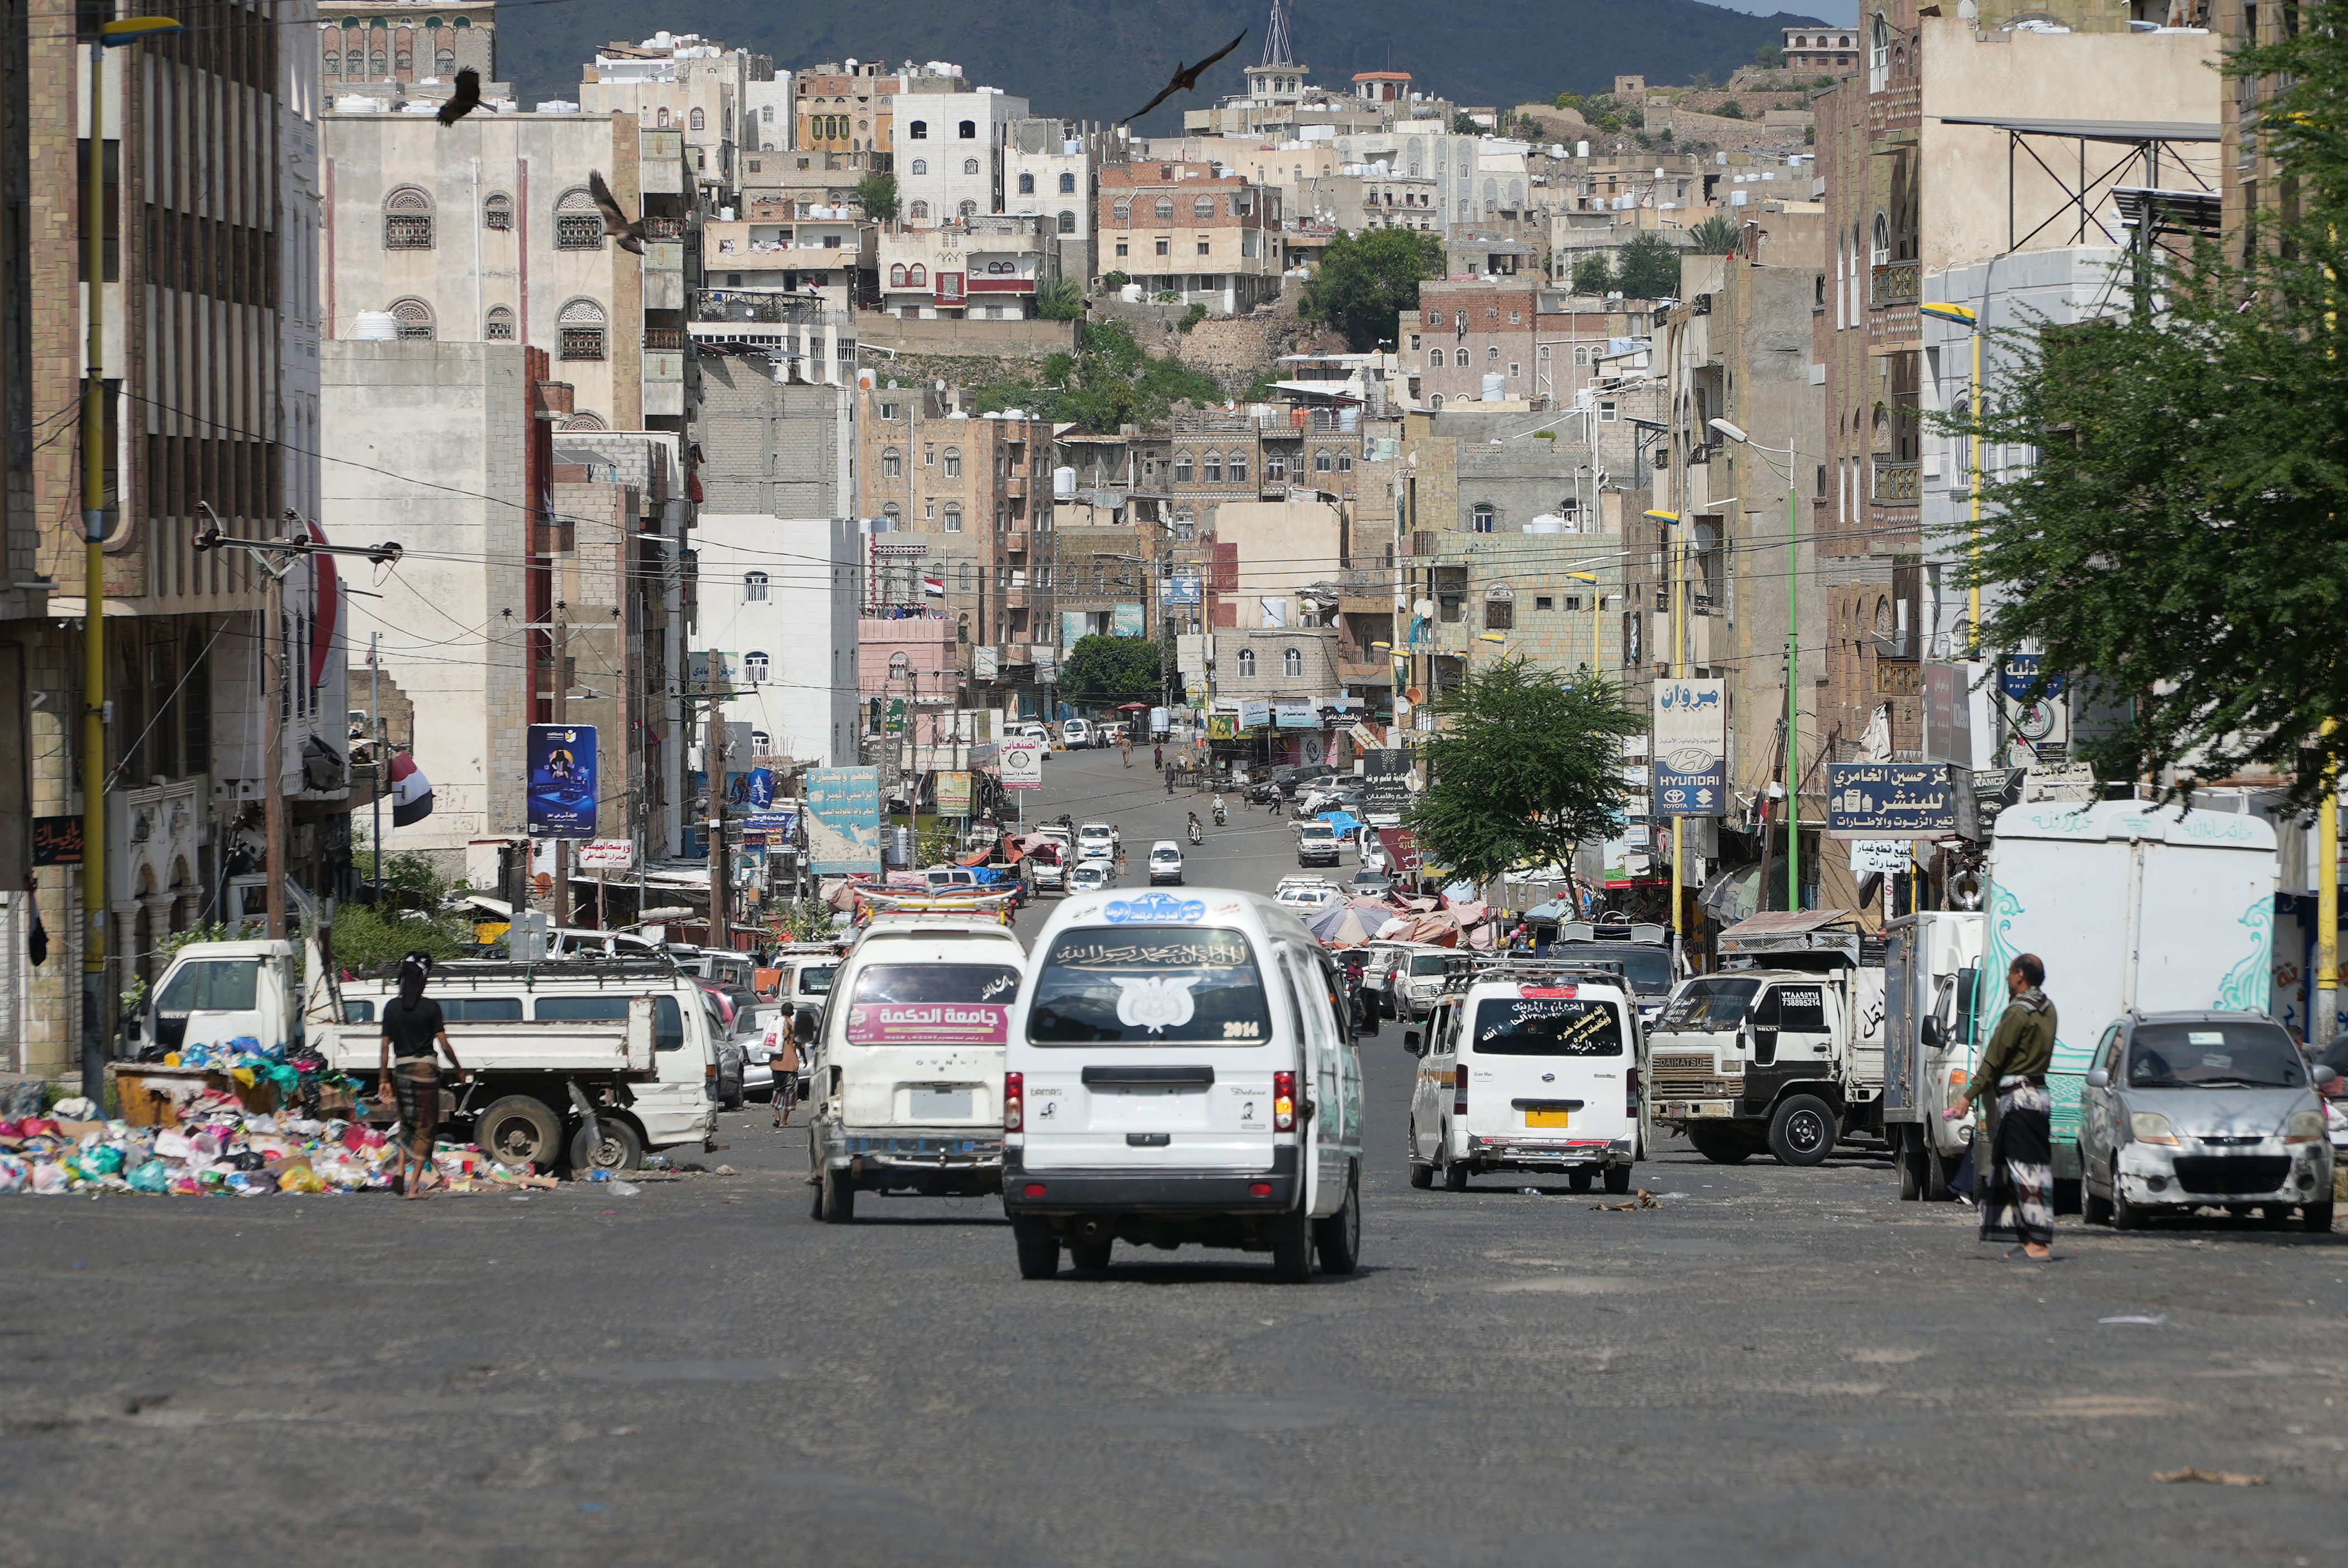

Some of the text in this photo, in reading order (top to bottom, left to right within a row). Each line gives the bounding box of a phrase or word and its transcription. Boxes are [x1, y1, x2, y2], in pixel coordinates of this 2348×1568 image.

[1661, 683, 1720, 711] مروان
[1001, 740, 1039, 755] الصنعاني
[850, 770, 875, 784] مطعم
[1660, 776, 1720, 786] HYUNDAI
[1833, 767, 1889, 788] الخامري
[1891, 768, 1927, 787] حسين
[1973, 771, 2006, 789] RAMCO
[1874, 788, 1945, 816] للبنشر
[1837, 816, 1892, 828] والإطارات
[1893, 816, 1932, 829] الزيوت
[1856, 842, 1875, 854] غيار
[1875, 844, 1893, 856] قطع
[1869, 857, 1906, 870] السيارات
[1594, 1004, 1606, 1016] الله
[879, 1008, 999, 1027] جامعة الحكمة
[1223, 1021, 1259, 1038] 2014
[1659, 1057, 1703, 1067] DAIHATSU
